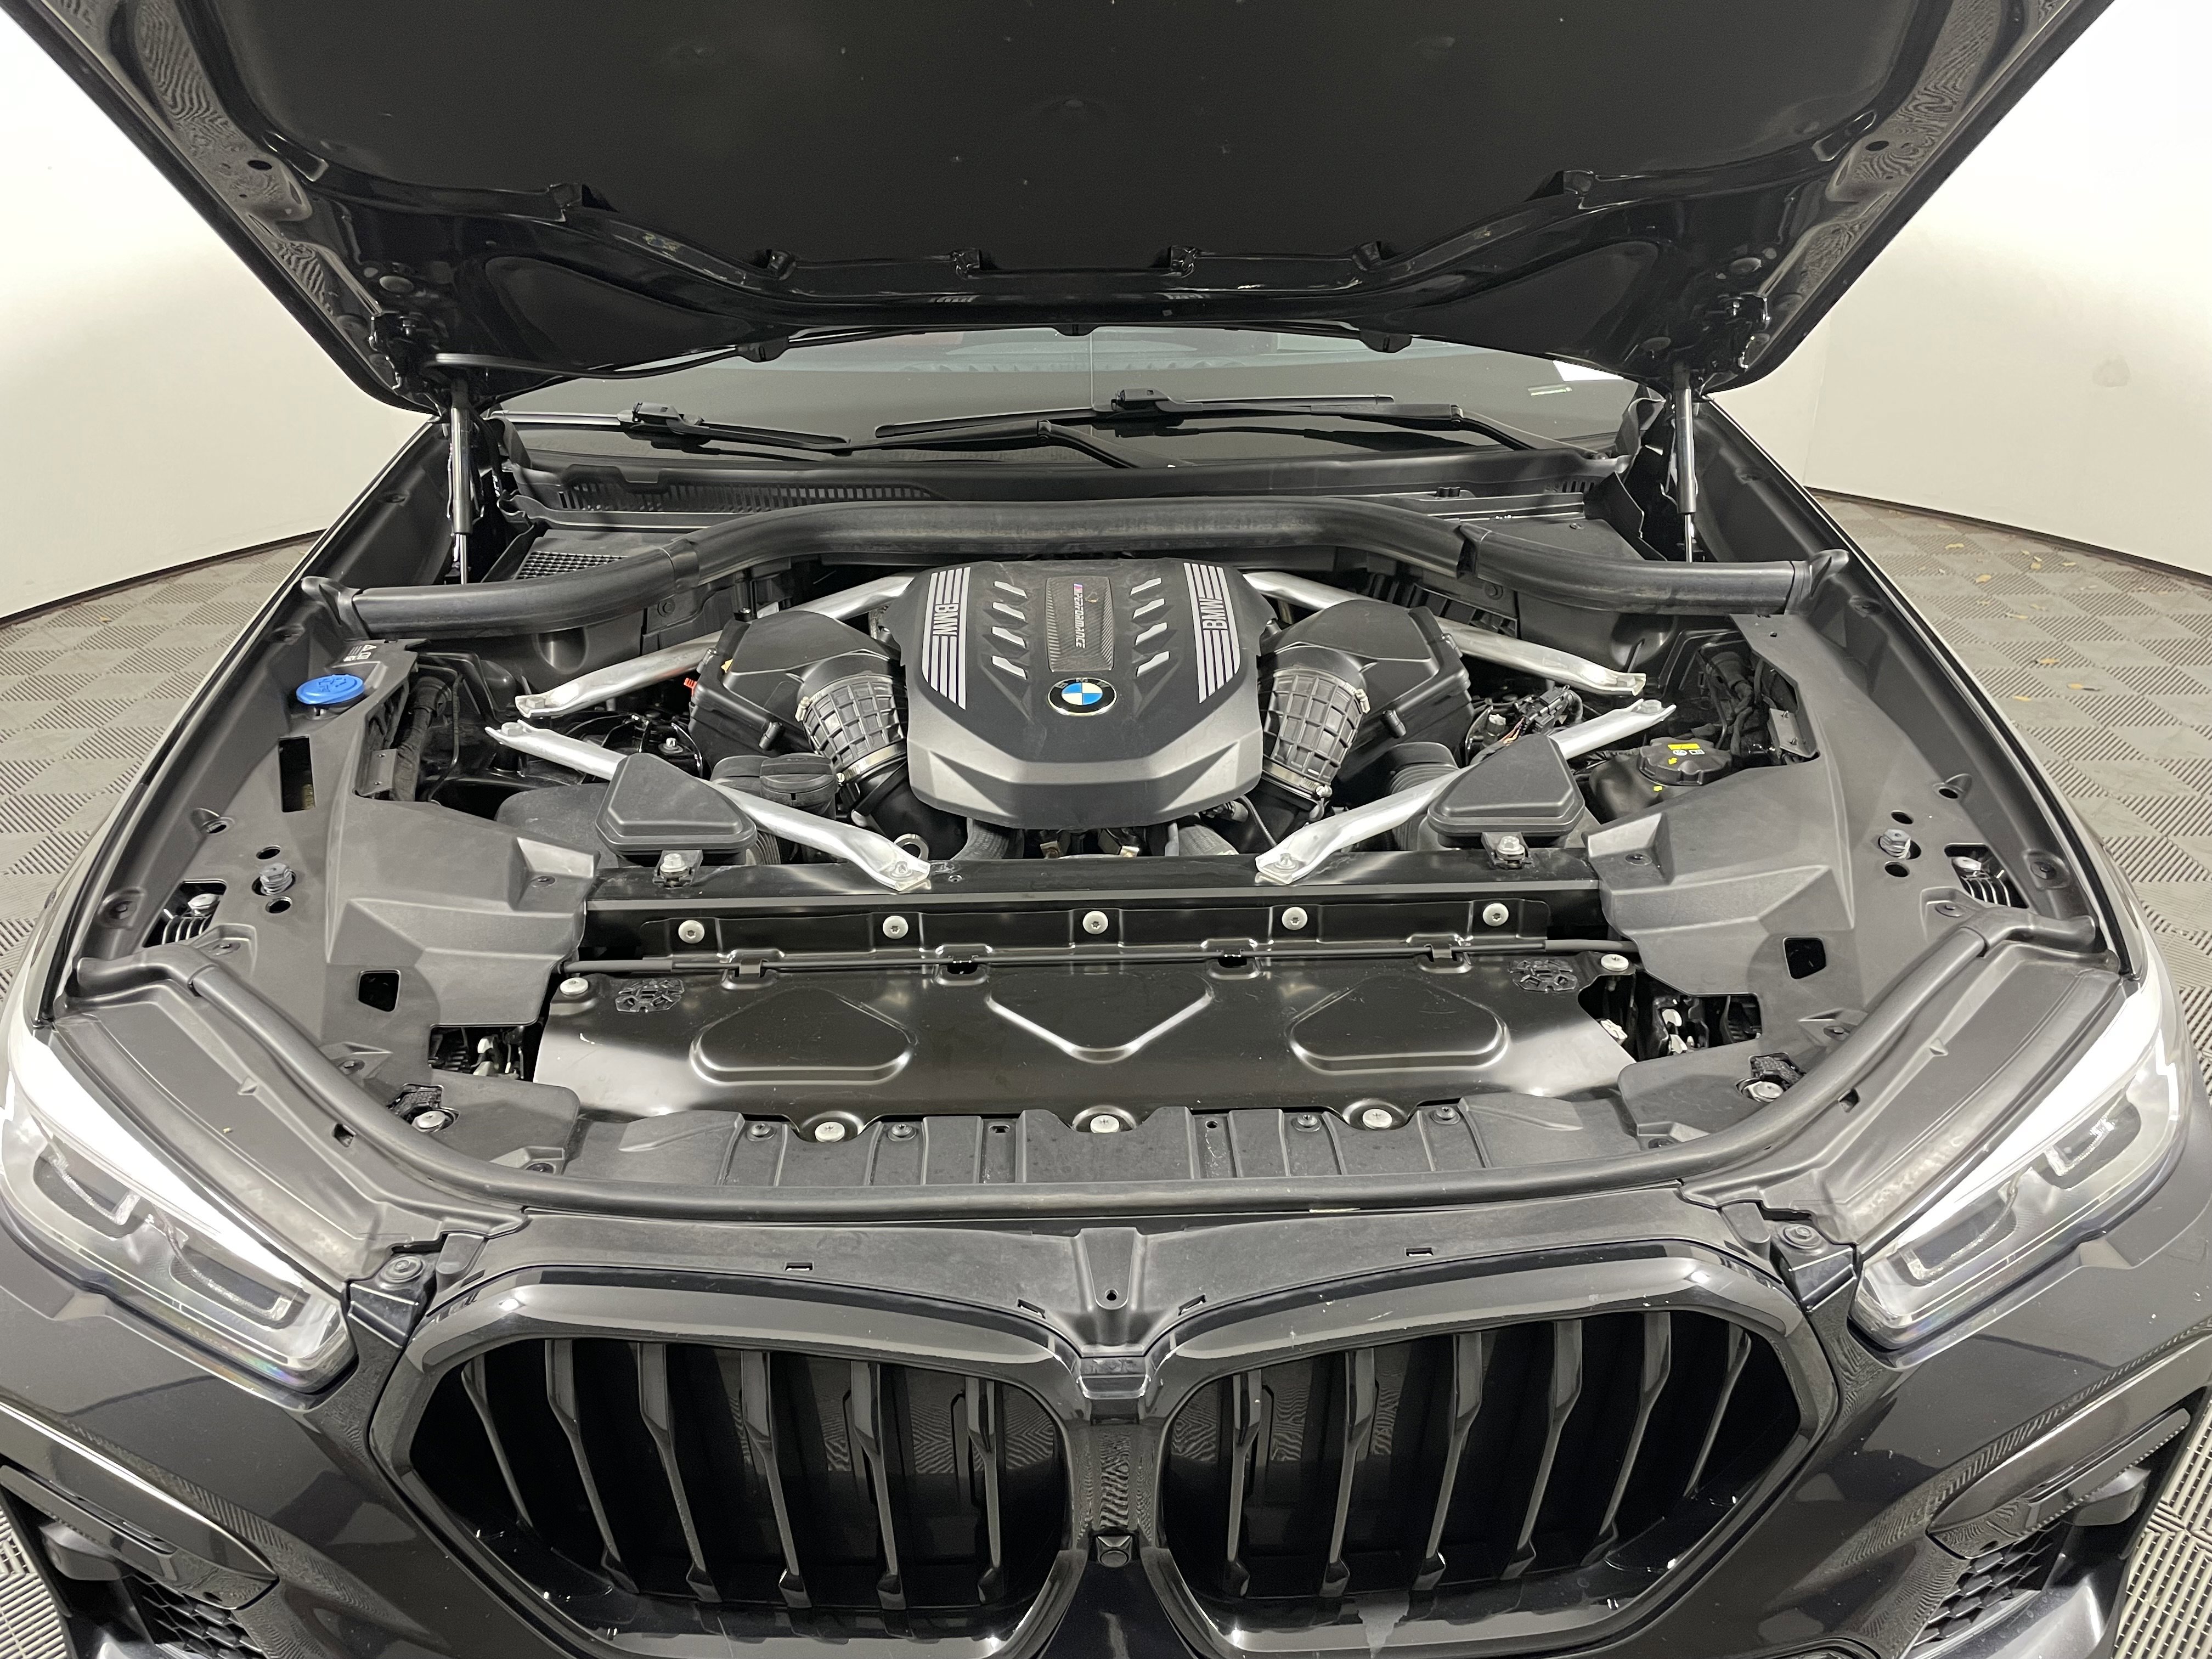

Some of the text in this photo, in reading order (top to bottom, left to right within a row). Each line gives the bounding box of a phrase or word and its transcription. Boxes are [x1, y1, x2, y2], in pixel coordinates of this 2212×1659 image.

[933, 603, 959, 635] BMW
[1074, 592, 1086, 649] PERFORMANCE
[1199, 597, 1228, 629] BMW
[1054, 677, 1111, 689] BMW
